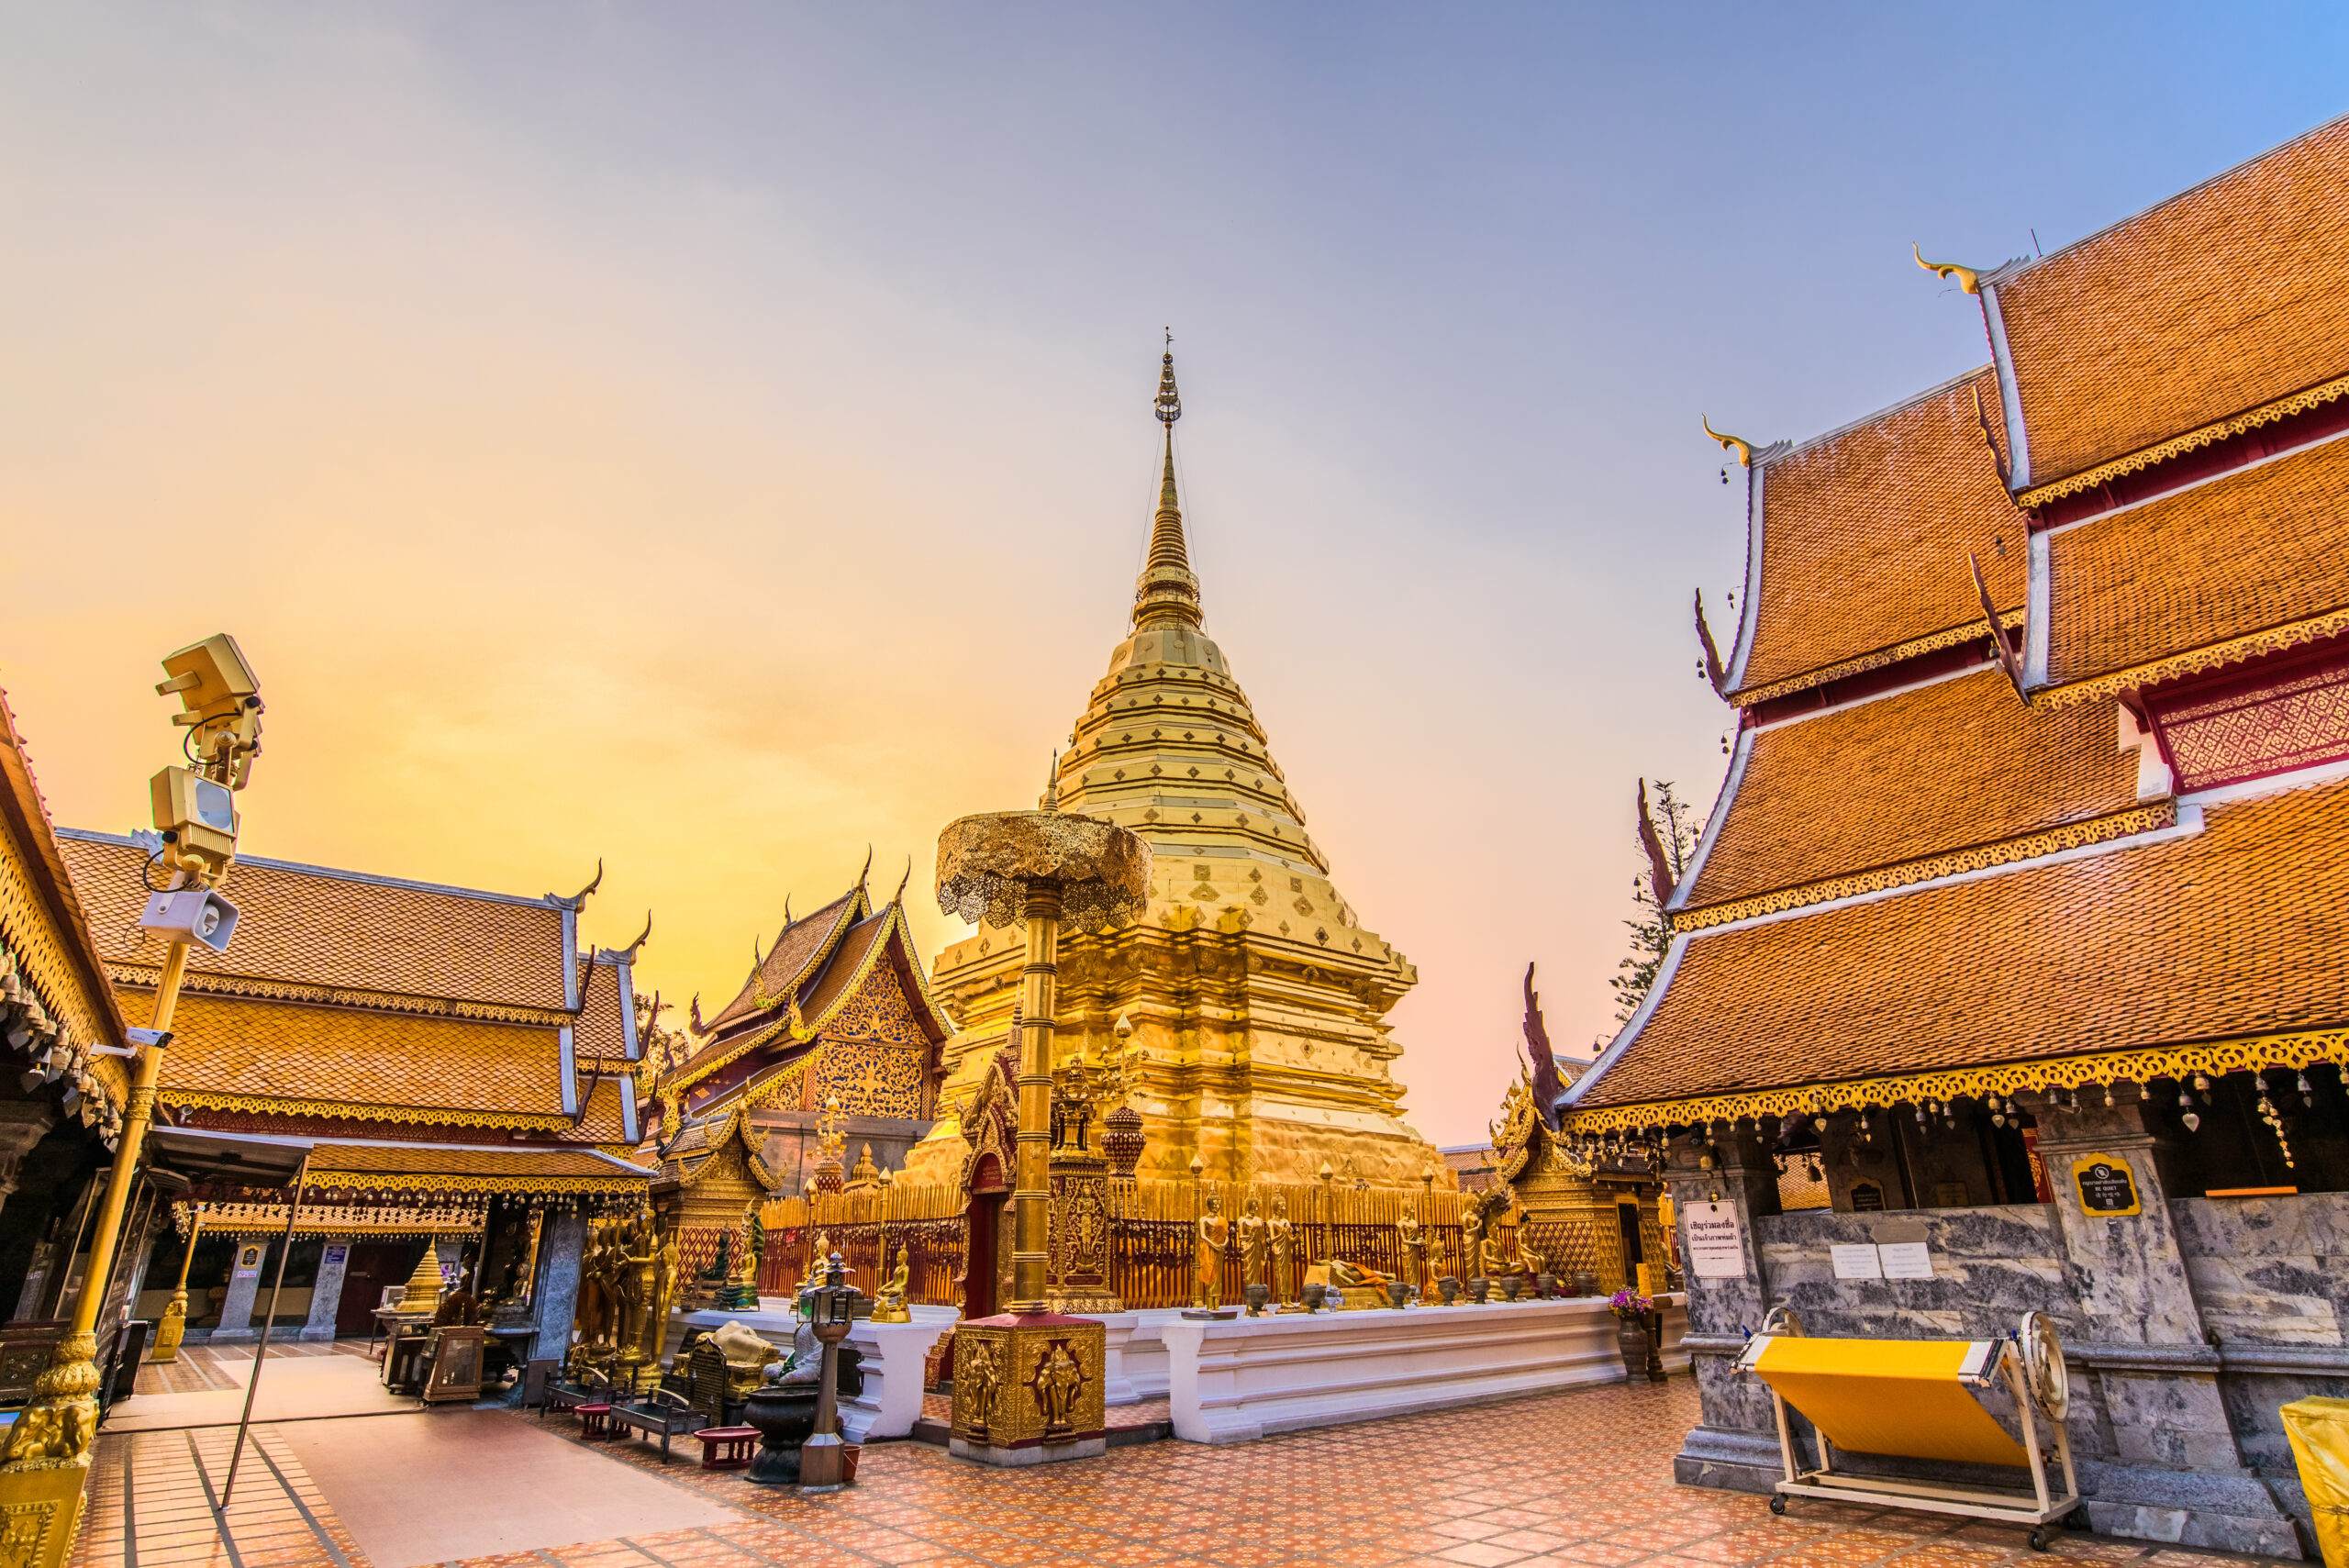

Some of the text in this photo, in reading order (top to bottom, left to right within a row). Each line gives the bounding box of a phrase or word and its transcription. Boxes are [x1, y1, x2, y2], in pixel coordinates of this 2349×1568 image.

[1690, 1217, 1734, 1230] เชิญร่วมลงชื่อ
